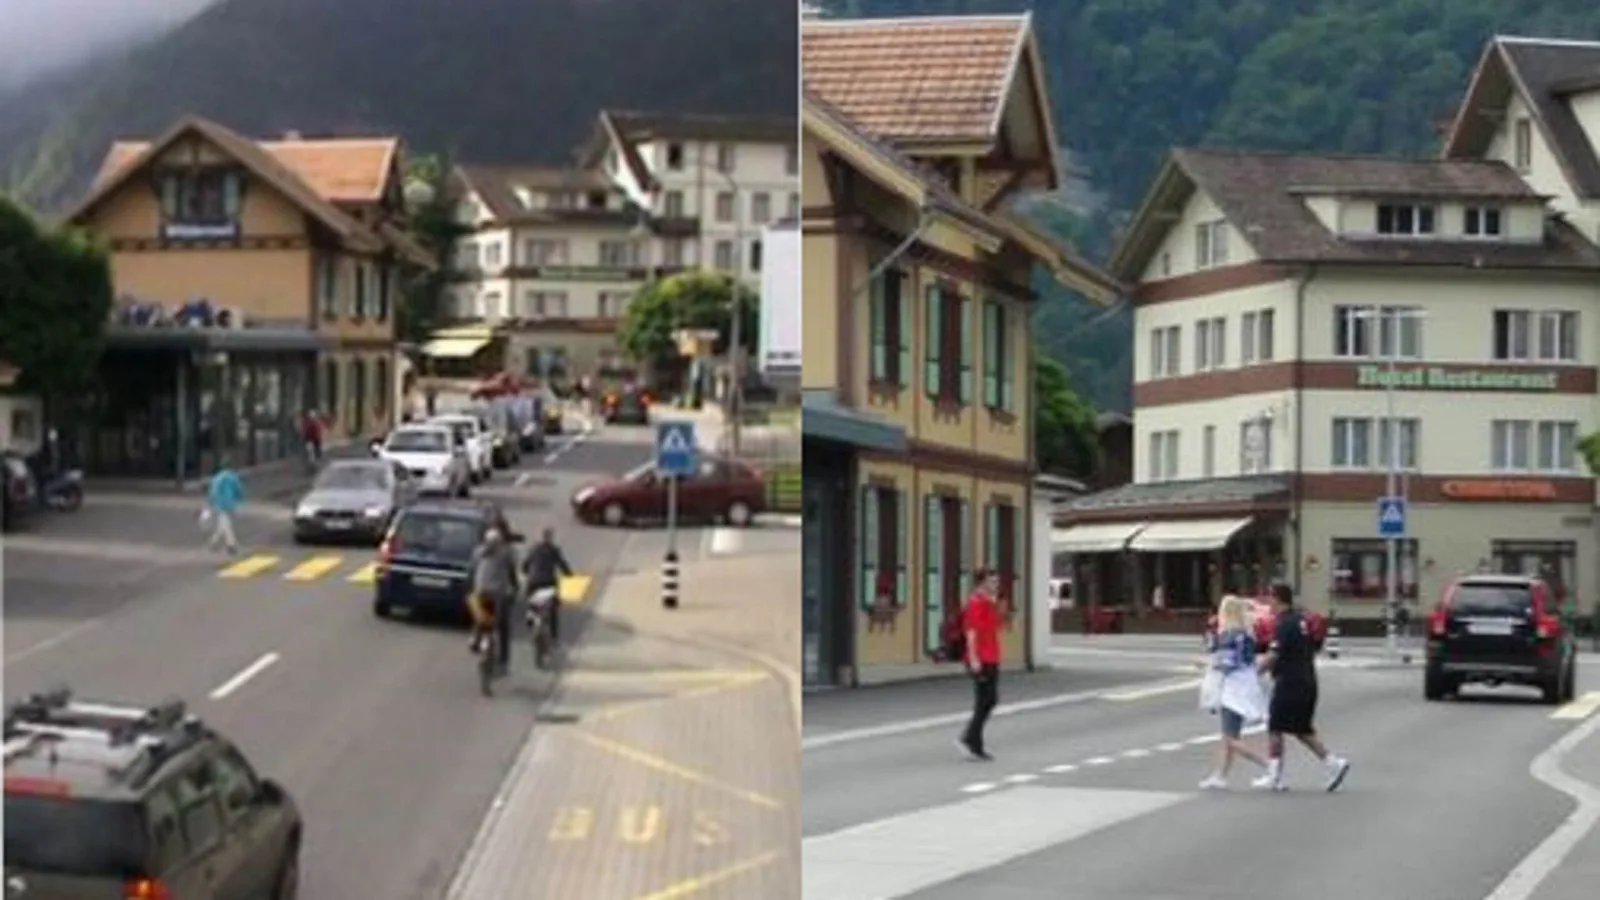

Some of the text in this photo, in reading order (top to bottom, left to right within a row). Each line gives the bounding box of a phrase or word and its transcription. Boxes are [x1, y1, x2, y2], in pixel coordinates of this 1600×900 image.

[1357, 364, 1557, 389] Hotel Restaurant
[548, 804, 729, 846] BUS
